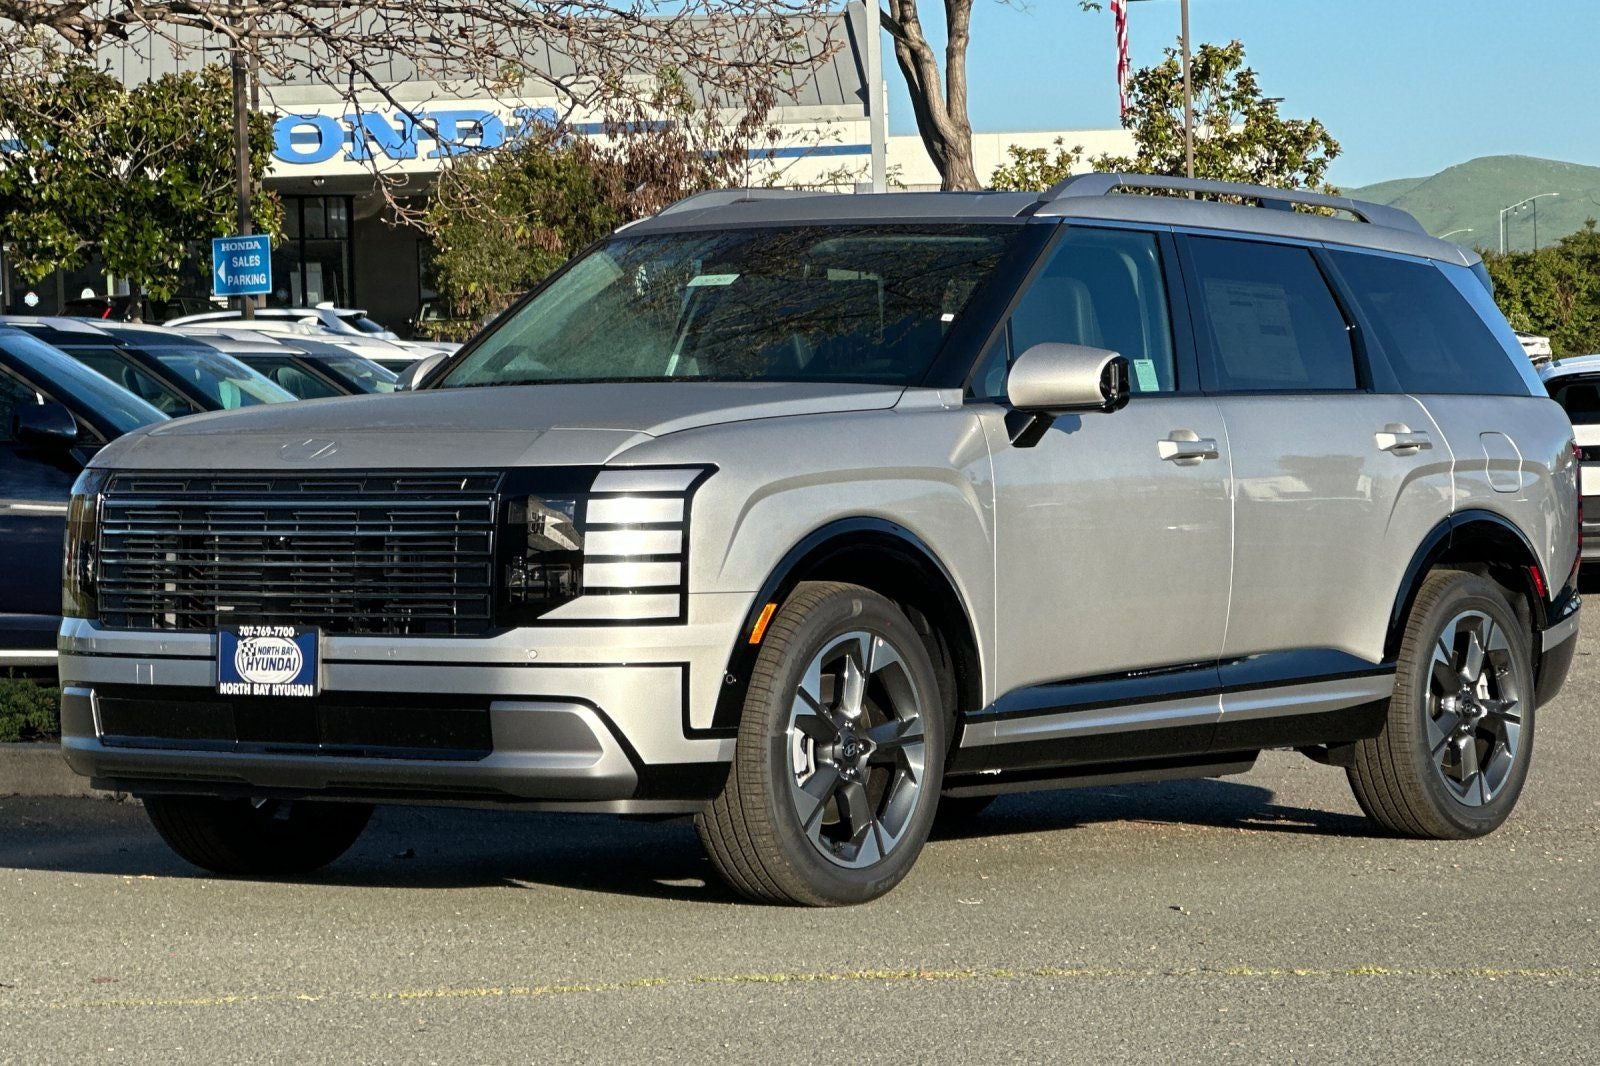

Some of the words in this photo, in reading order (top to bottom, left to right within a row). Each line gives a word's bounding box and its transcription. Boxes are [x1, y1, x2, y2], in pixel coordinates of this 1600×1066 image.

[221, 241, 261, 252] HONDA
[232, 255, 261, 267] SALES
[227, 273, 267, 286] PARKING
[239, 626, 295, 637] 707-769-7700
[257, 646, 280, 656] NORTH
[281, 646, 295, 656] BAY
[246, 657, 297, 671] HYUNDAI
[219, 682, 252, 695] NORTH
[253, 683, 269, 695] BAY
[272, 684, 314, 697] HYUNDAI
